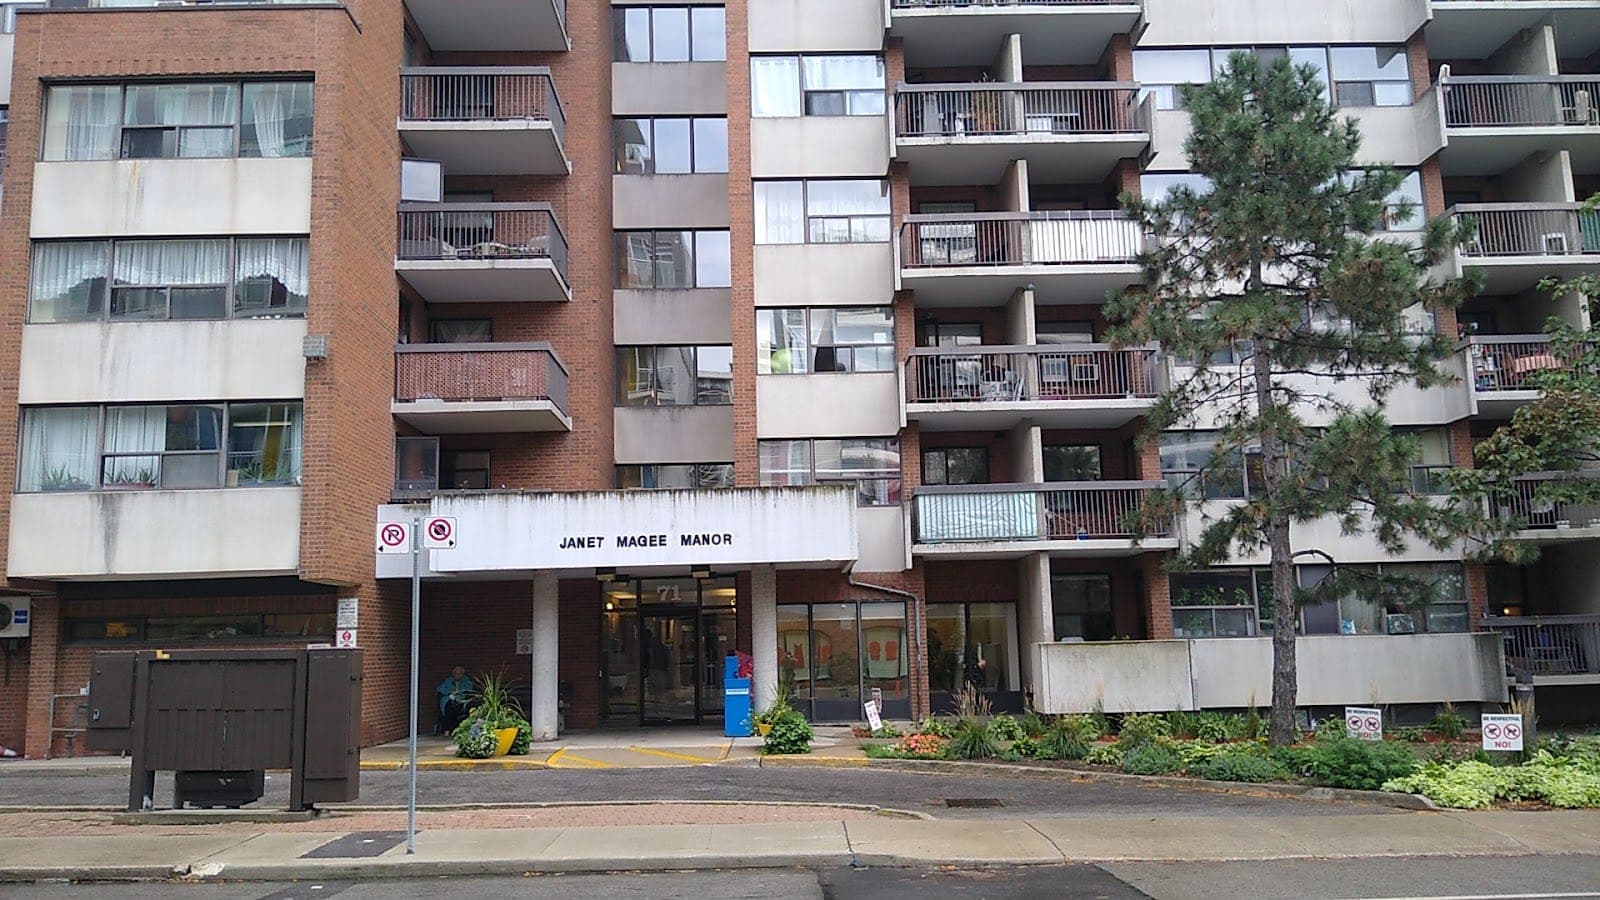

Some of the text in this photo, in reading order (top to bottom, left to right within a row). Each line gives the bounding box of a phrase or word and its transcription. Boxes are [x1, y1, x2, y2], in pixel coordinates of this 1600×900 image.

[388, 529, 400, 541] P
[559, 533, 732, 549] JANET MAGEE MANOR
[656, 585, 681, 601] 71
[1494, 741, 1511, 749] NO!
